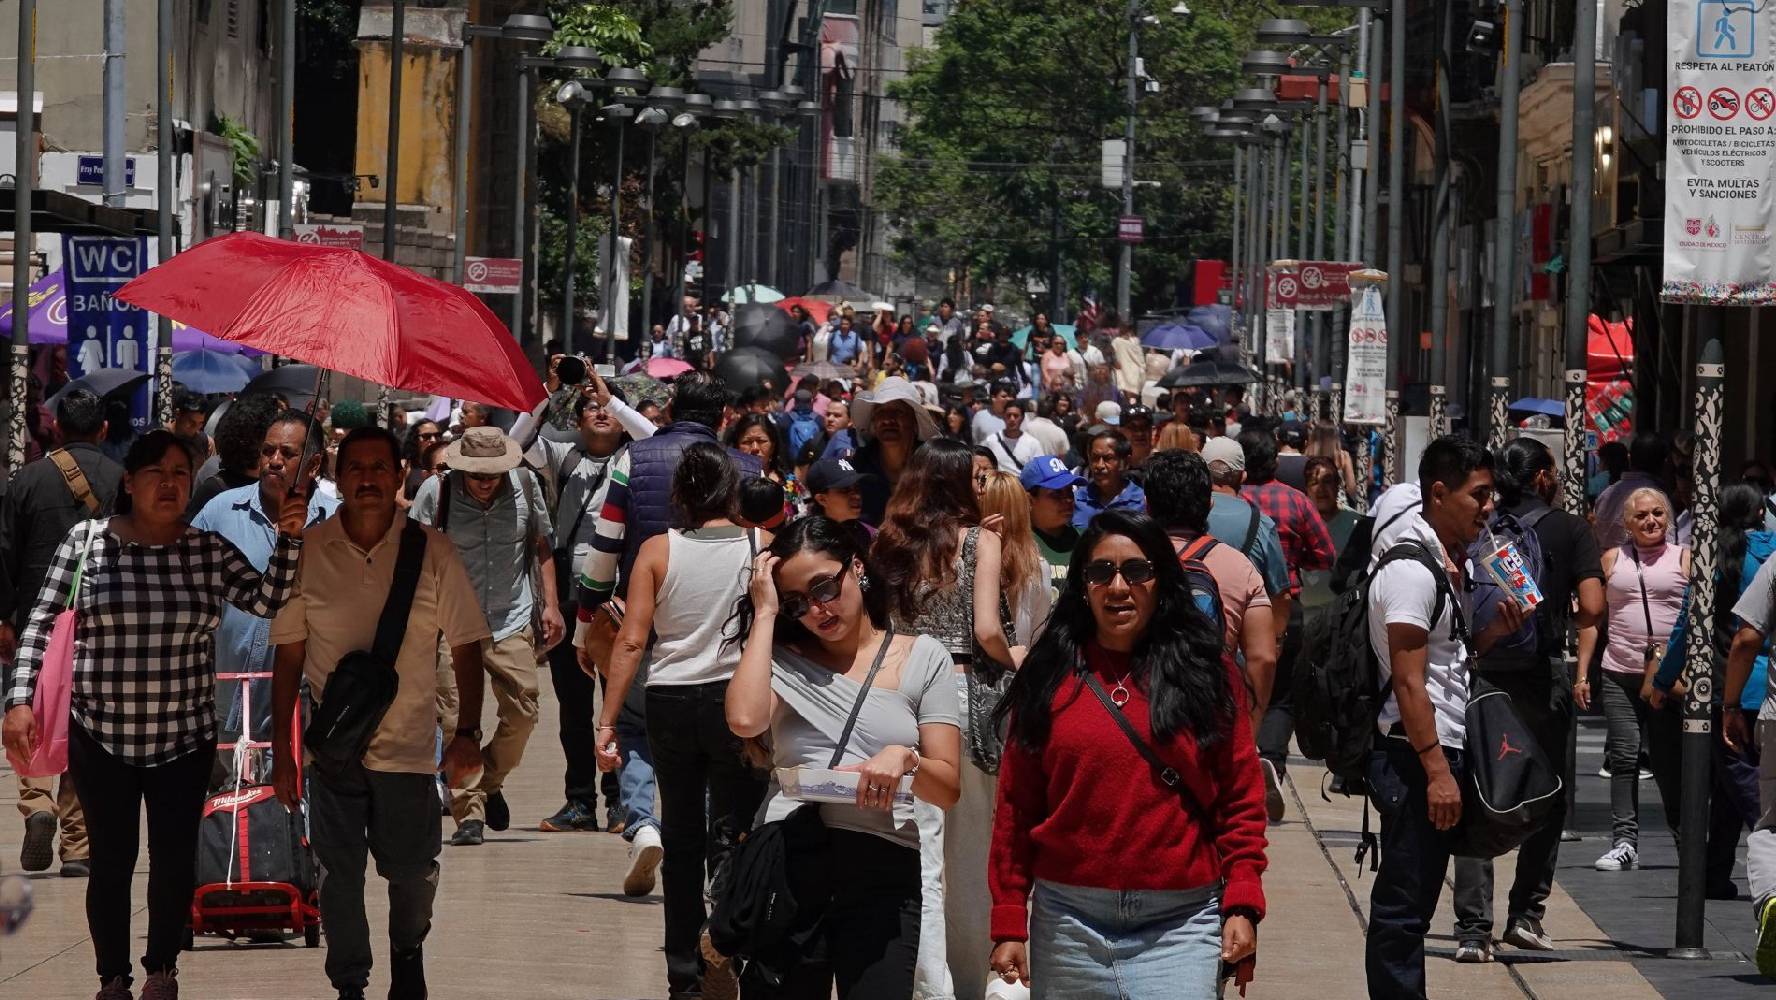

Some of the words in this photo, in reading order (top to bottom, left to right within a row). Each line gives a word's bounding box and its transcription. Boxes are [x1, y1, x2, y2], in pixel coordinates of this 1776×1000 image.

[1675, 62, 1718, 71] RESPETA
[1720, 63, 1734, 71] AL
[1736, 61, 1775, 72] PEATÓN
[1671, 125, 1723, 135] PROHIBIDO
[1725, 126, 1737, 135] EL
[1739, 126, 1765, 136] PASO
[1672, 139, 1727, 147] MOTOCICLETAS
[1733, 140, 1776, 148] BCICLETAS
[1681, 148, 1721, 157] VEHÍCULOS
[1722, 149, 1767, 157] ELÉCTRICOS
[1687, 178, 1715, 188] EVITA
[1717, 179, 1760, 189] MULTAS
[1689, 188, 1697, 198] Y
[1699, 188, 1757, 199] SANCIONES
[78, 246, 132, 272] WC
